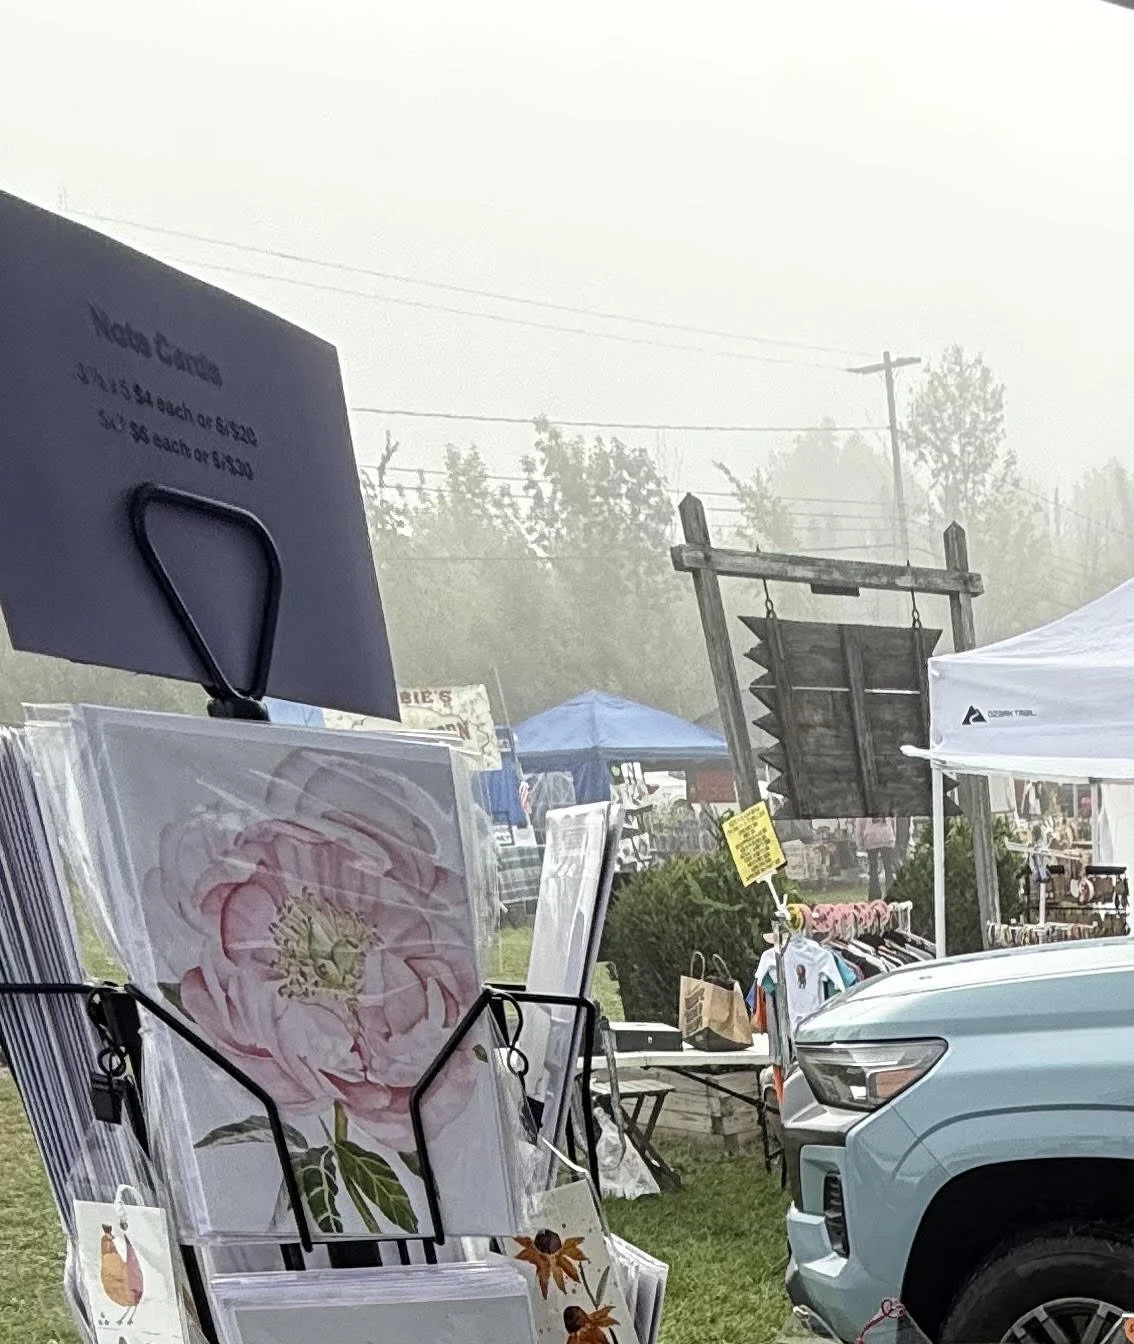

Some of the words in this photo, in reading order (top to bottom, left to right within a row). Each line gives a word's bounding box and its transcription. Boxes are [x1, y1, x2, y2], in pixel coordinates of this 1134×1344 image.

[157, 396, 194, 424] each
[198, 412, 212, 429] or
[152, 432, 192, 459] each
[194, 448, 209, 465] or
